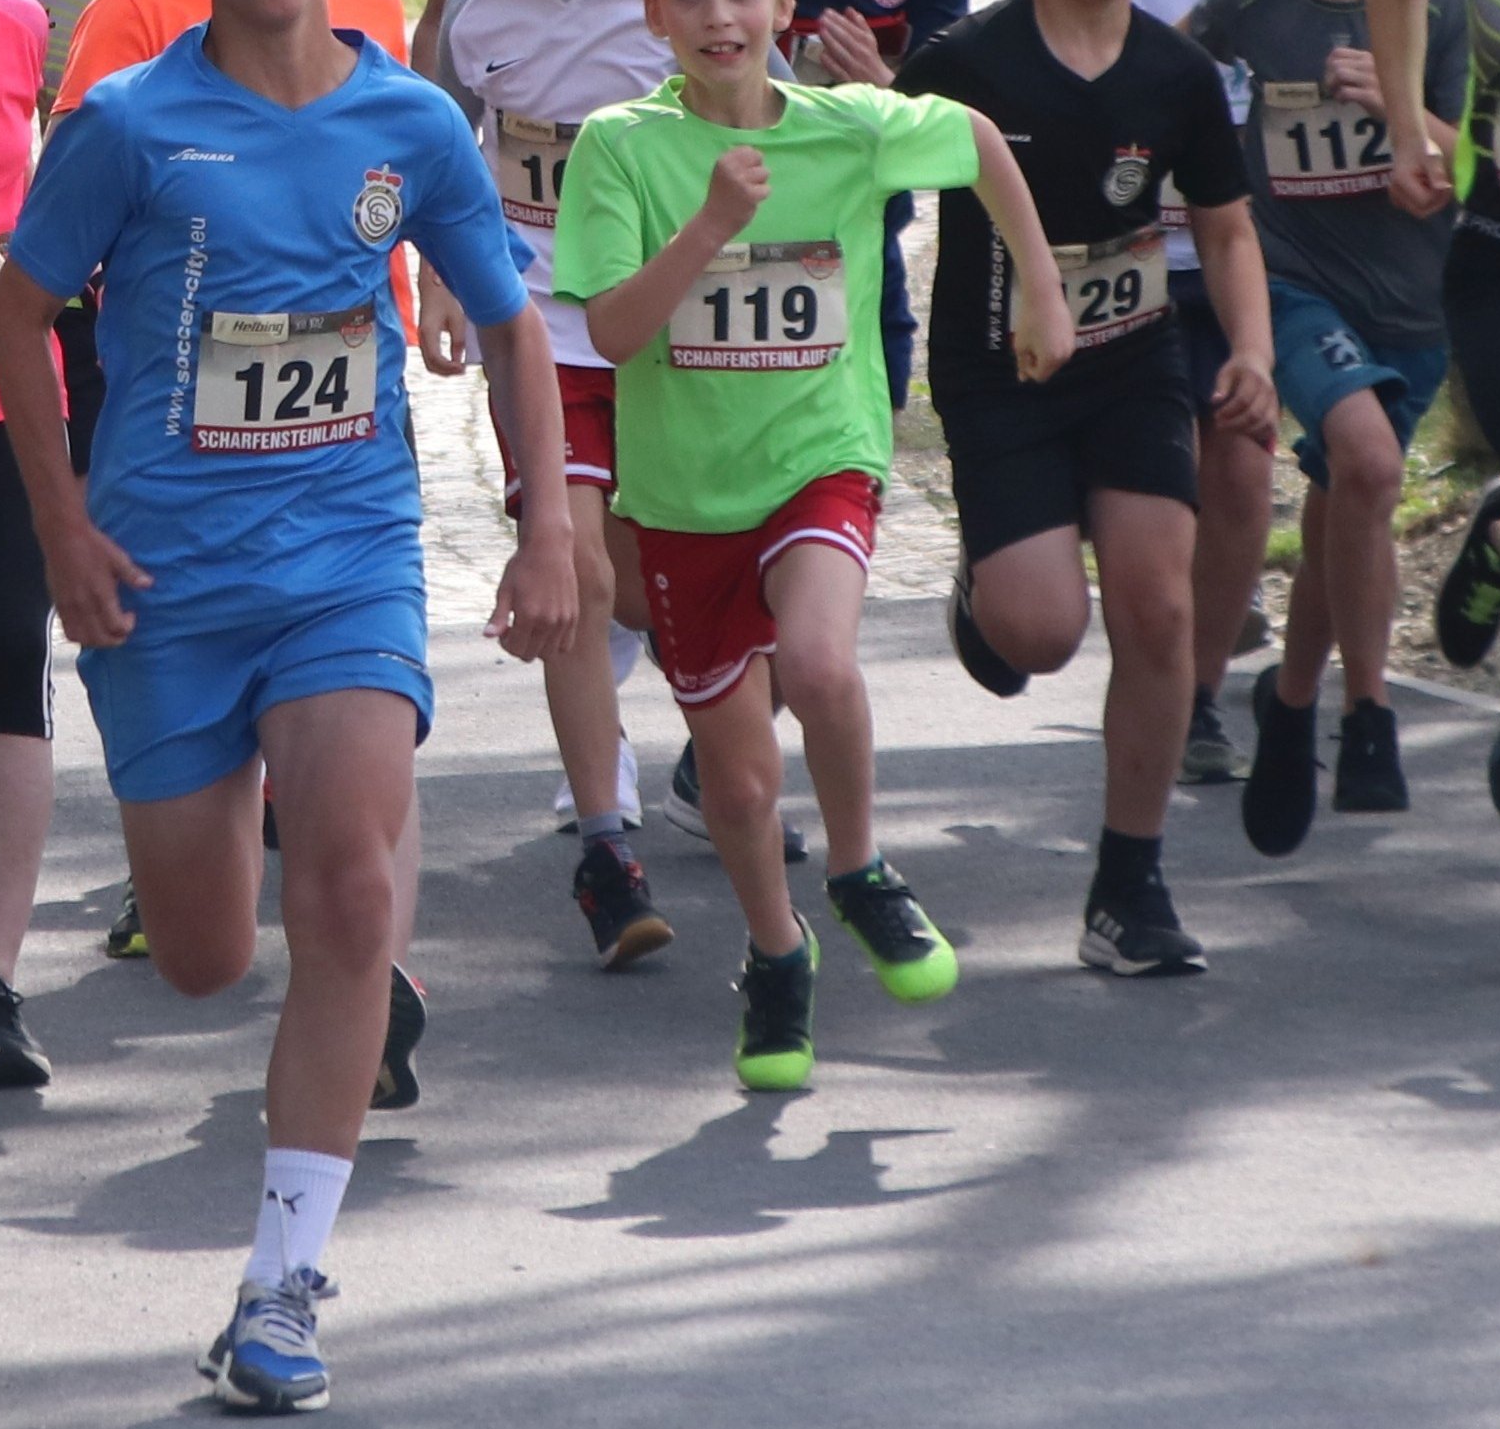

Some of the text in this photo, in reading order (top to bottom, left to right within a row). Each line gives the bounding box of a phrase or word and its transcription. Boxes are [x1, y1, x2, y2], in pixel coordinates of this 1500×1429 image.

[1287, 117, 1393, 173] 112
[704, 285, 818, 342] 119
[1078, 268, 1144, 326] 29
[165, 217, 208, 437] www.soccer-city.eu
[232, 320, 285, 337] Helbing
[673, 349, 828, 369] SCHARFENSTEINLAUF
[235, 355, 349, 421] 124
[198, 421, 354, 449] SCHARFENSTEINLAUF
